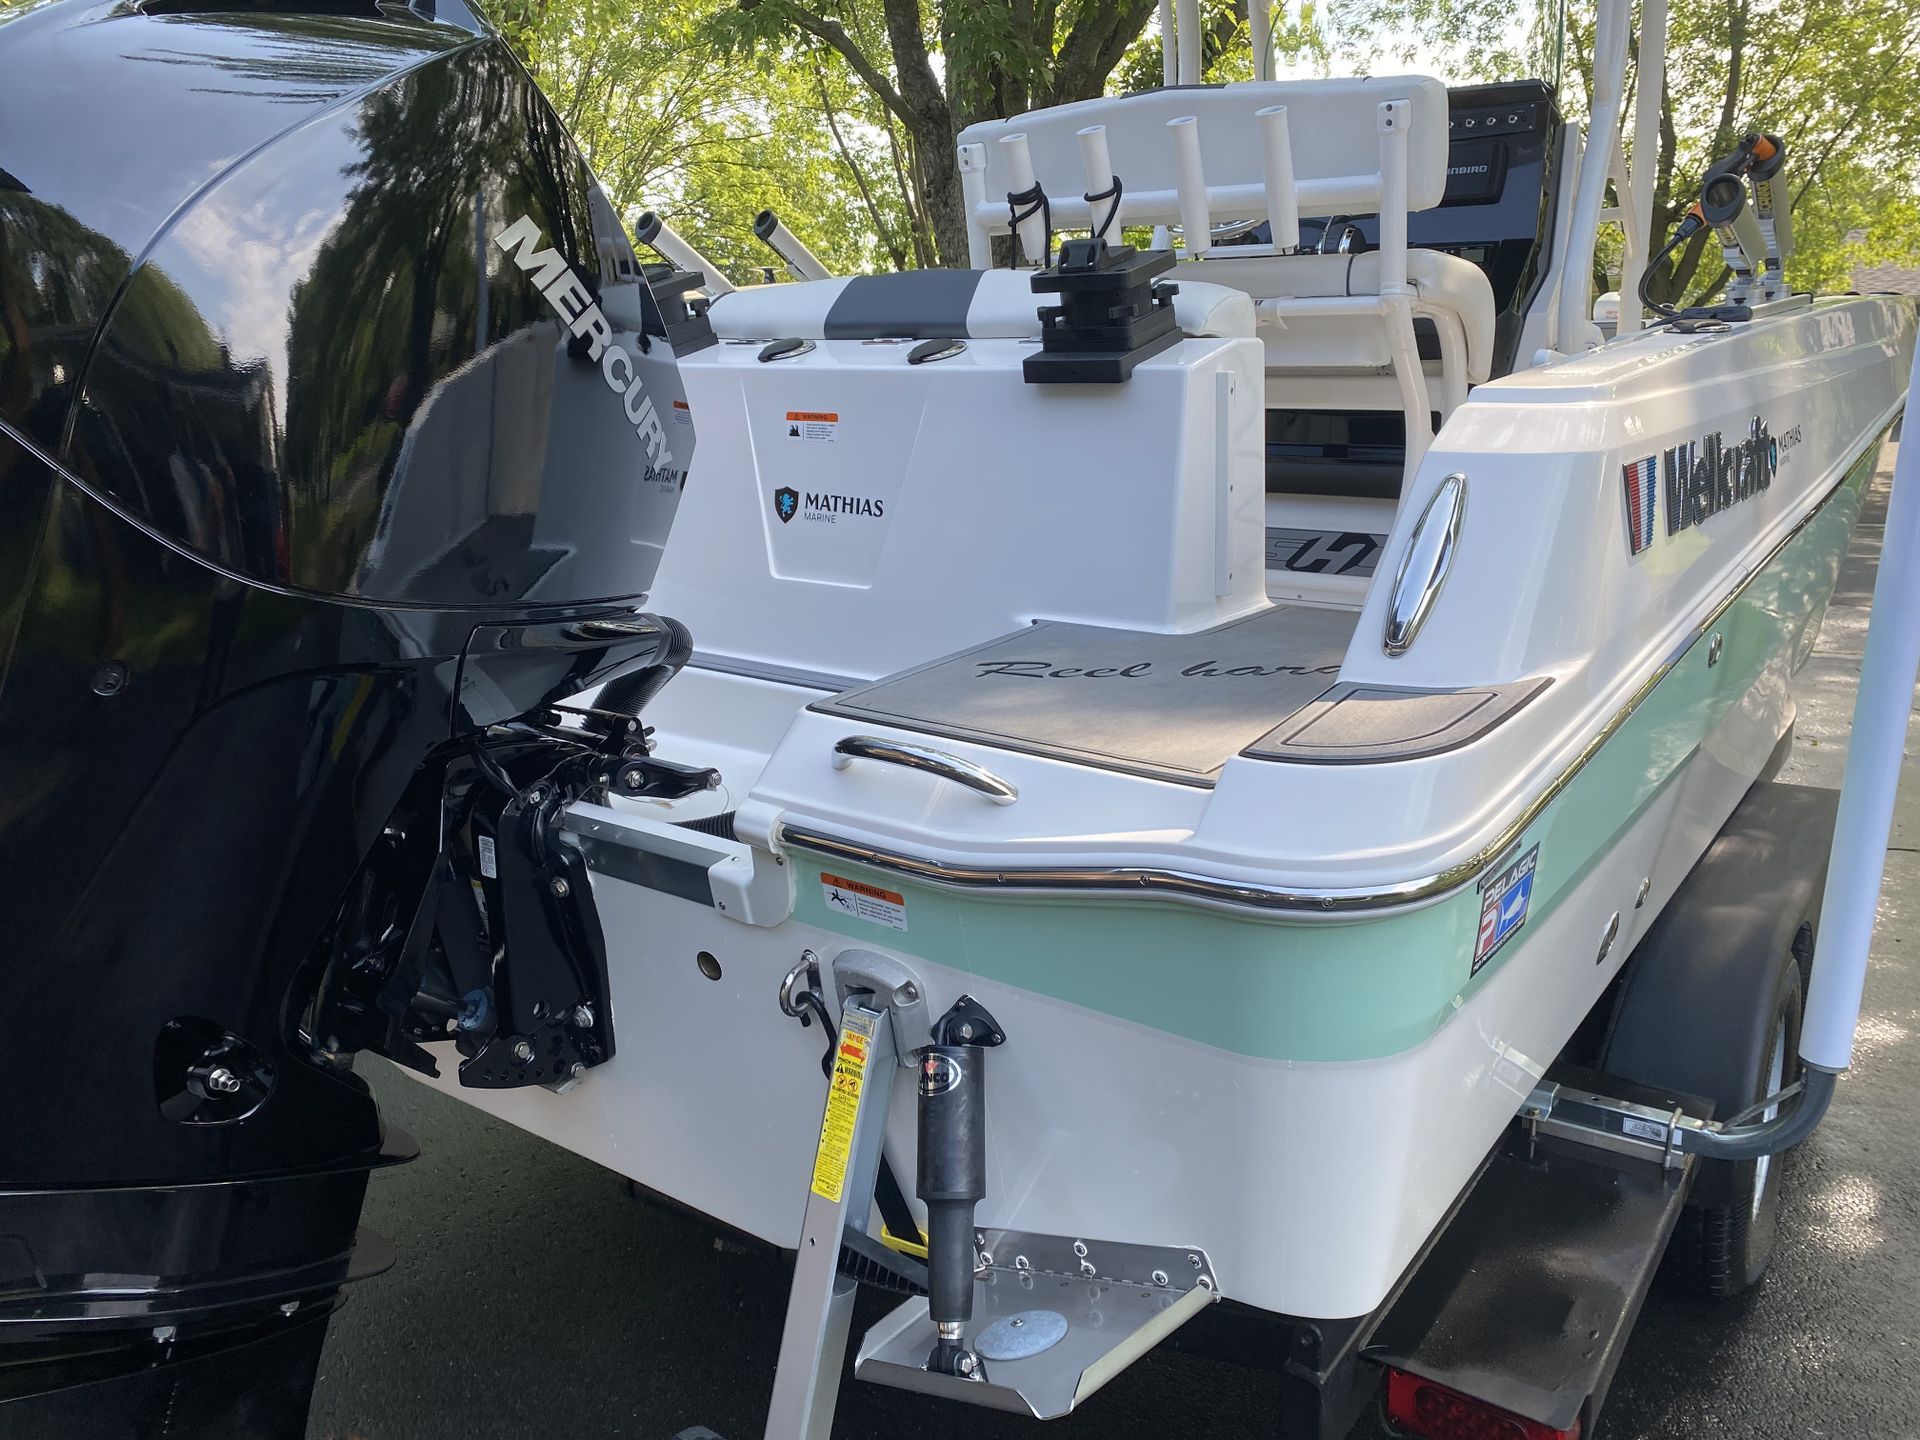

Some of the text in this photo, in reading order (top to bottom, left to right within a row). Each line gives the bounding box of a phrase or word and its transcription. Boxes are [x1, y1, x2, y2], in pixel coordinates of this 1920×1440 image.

[494, 214, 673, 468] MERCURY
[804, 492, 884, 518] MATHIAS
[804, 511, 837, 524] MARINE
[975, 660, 1152, 679] Reel
[846, 881, 887, 899] WARNING
[1483, 849, 1538, 912] PELAGIC
